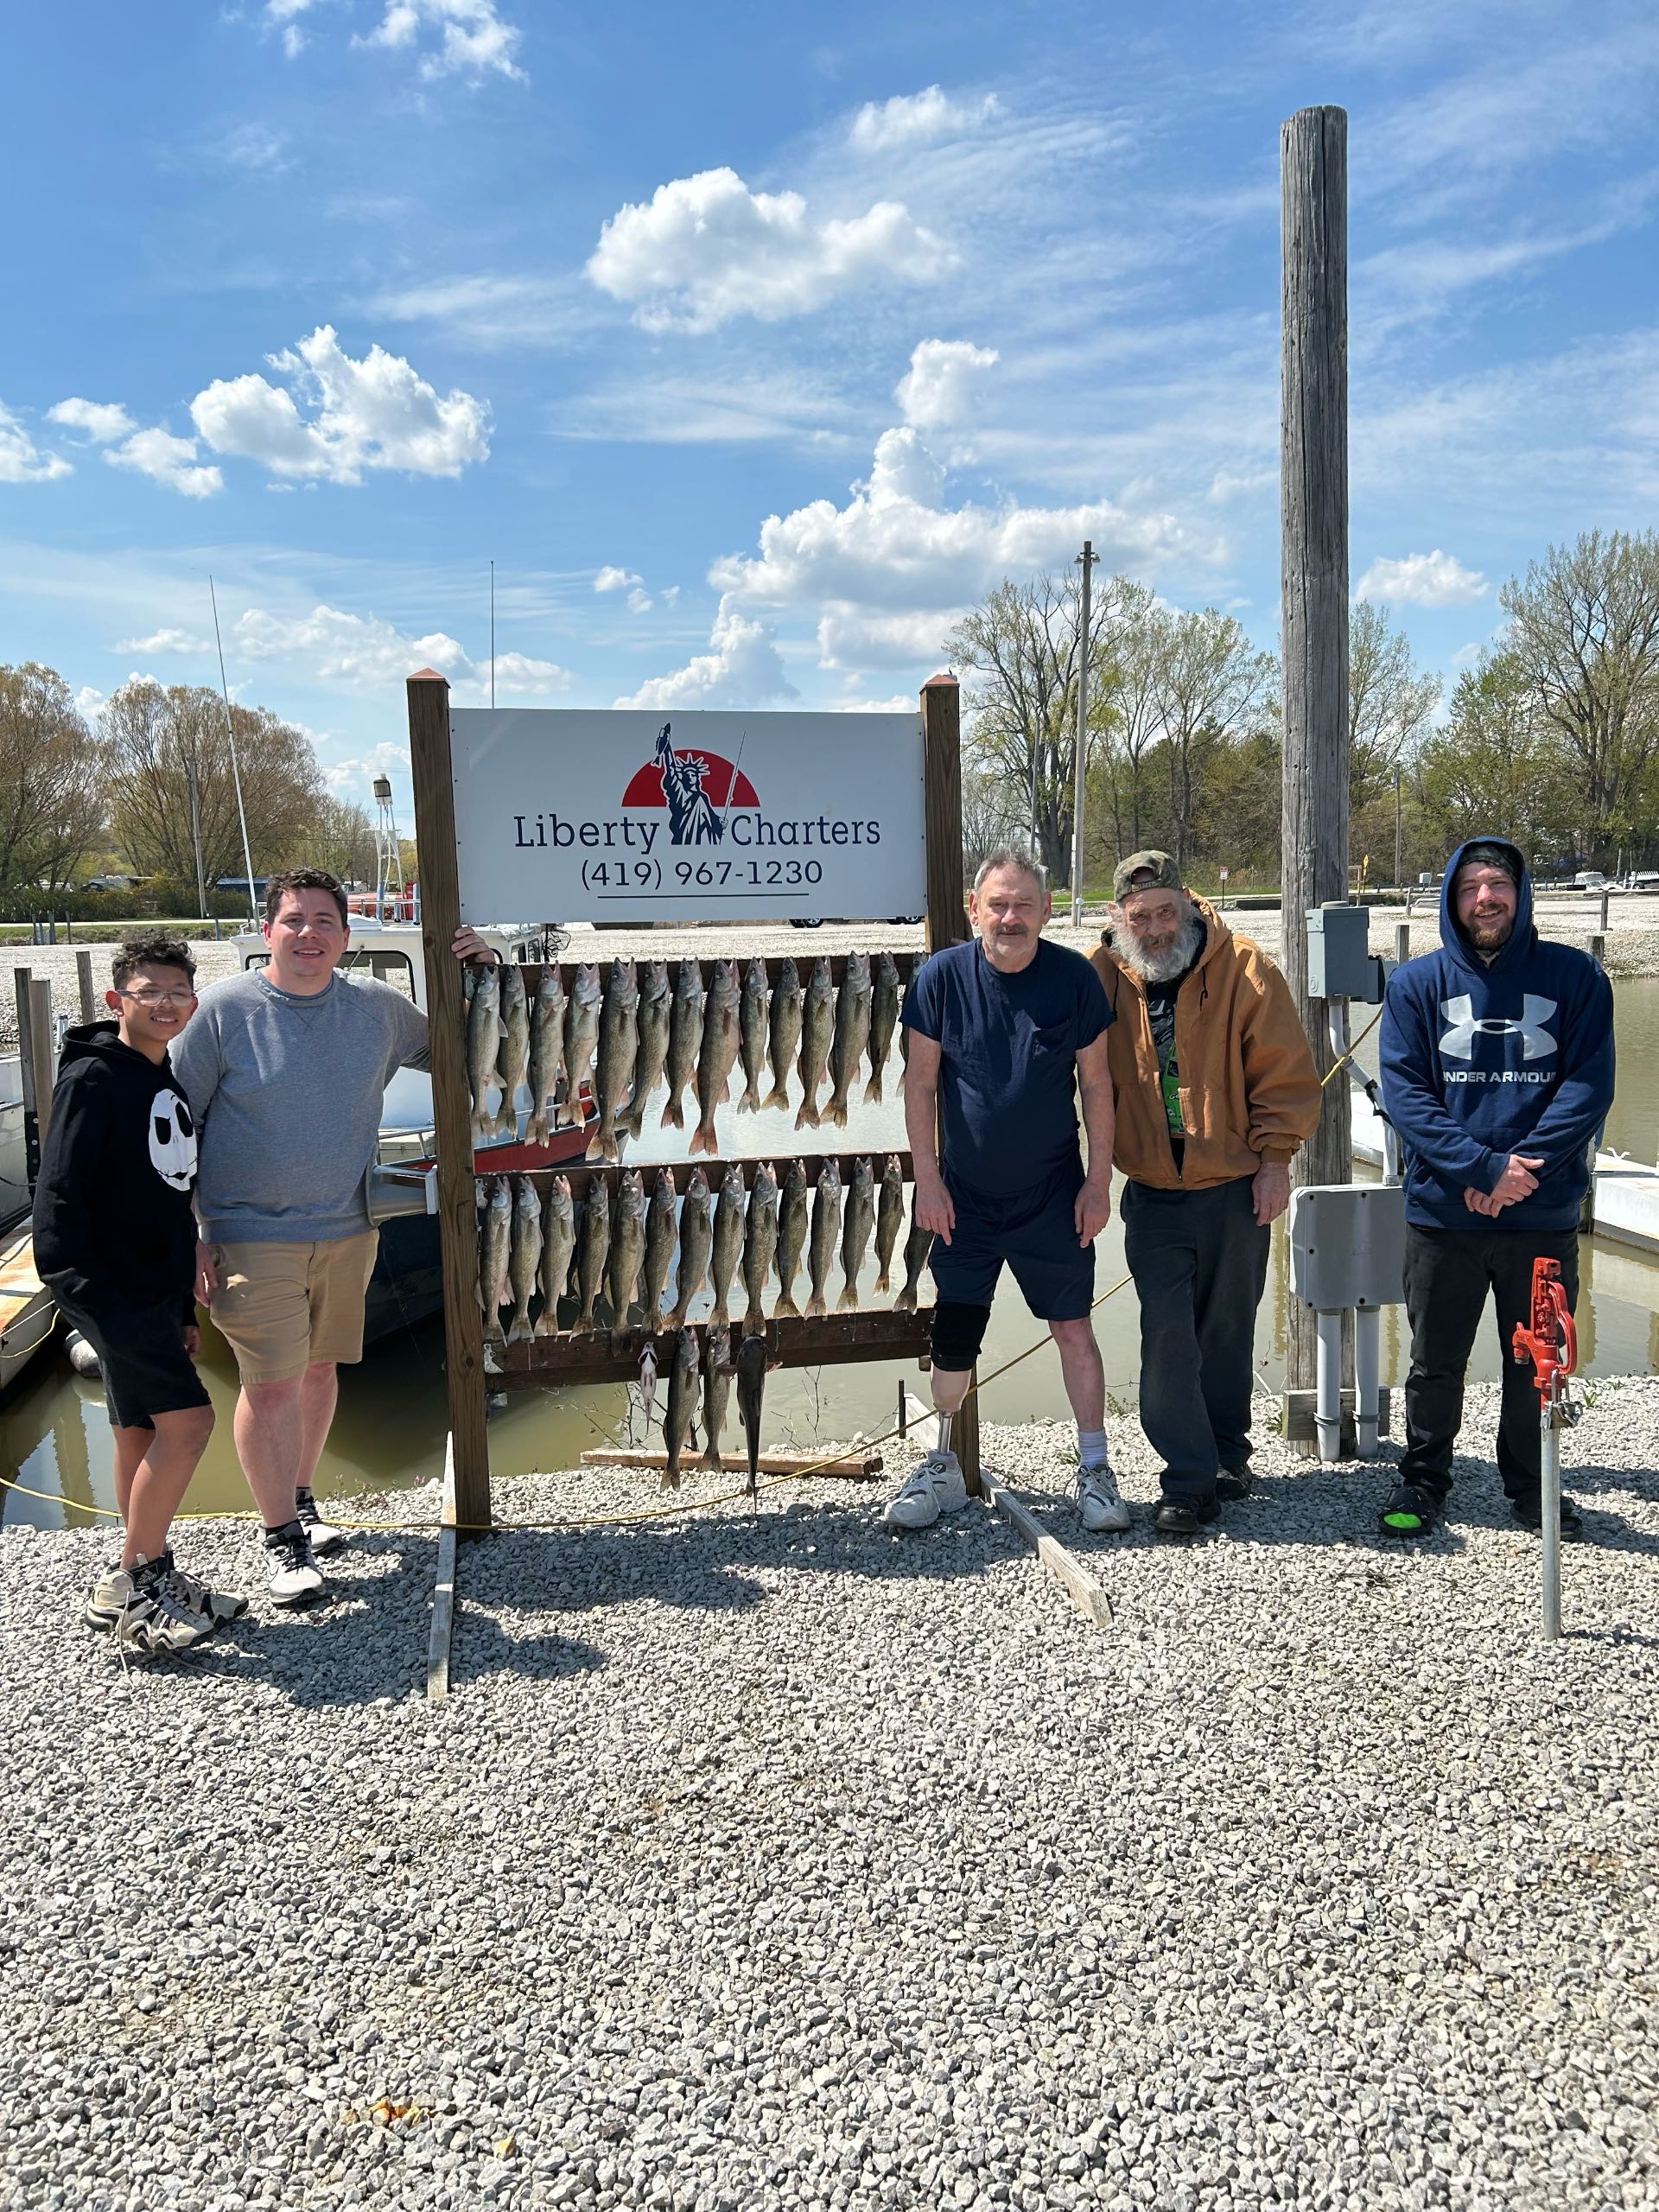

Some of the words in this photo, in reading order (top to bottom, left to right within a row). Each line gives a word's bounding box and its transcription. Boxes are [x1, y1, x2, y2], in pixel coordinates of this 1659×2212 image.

[513, 813, 659, 855] Liberty
[731, 813, 880, 846] Charters
[582, 859, 662, 891] (419)
[675, 861, 823, 886] 967-1230
